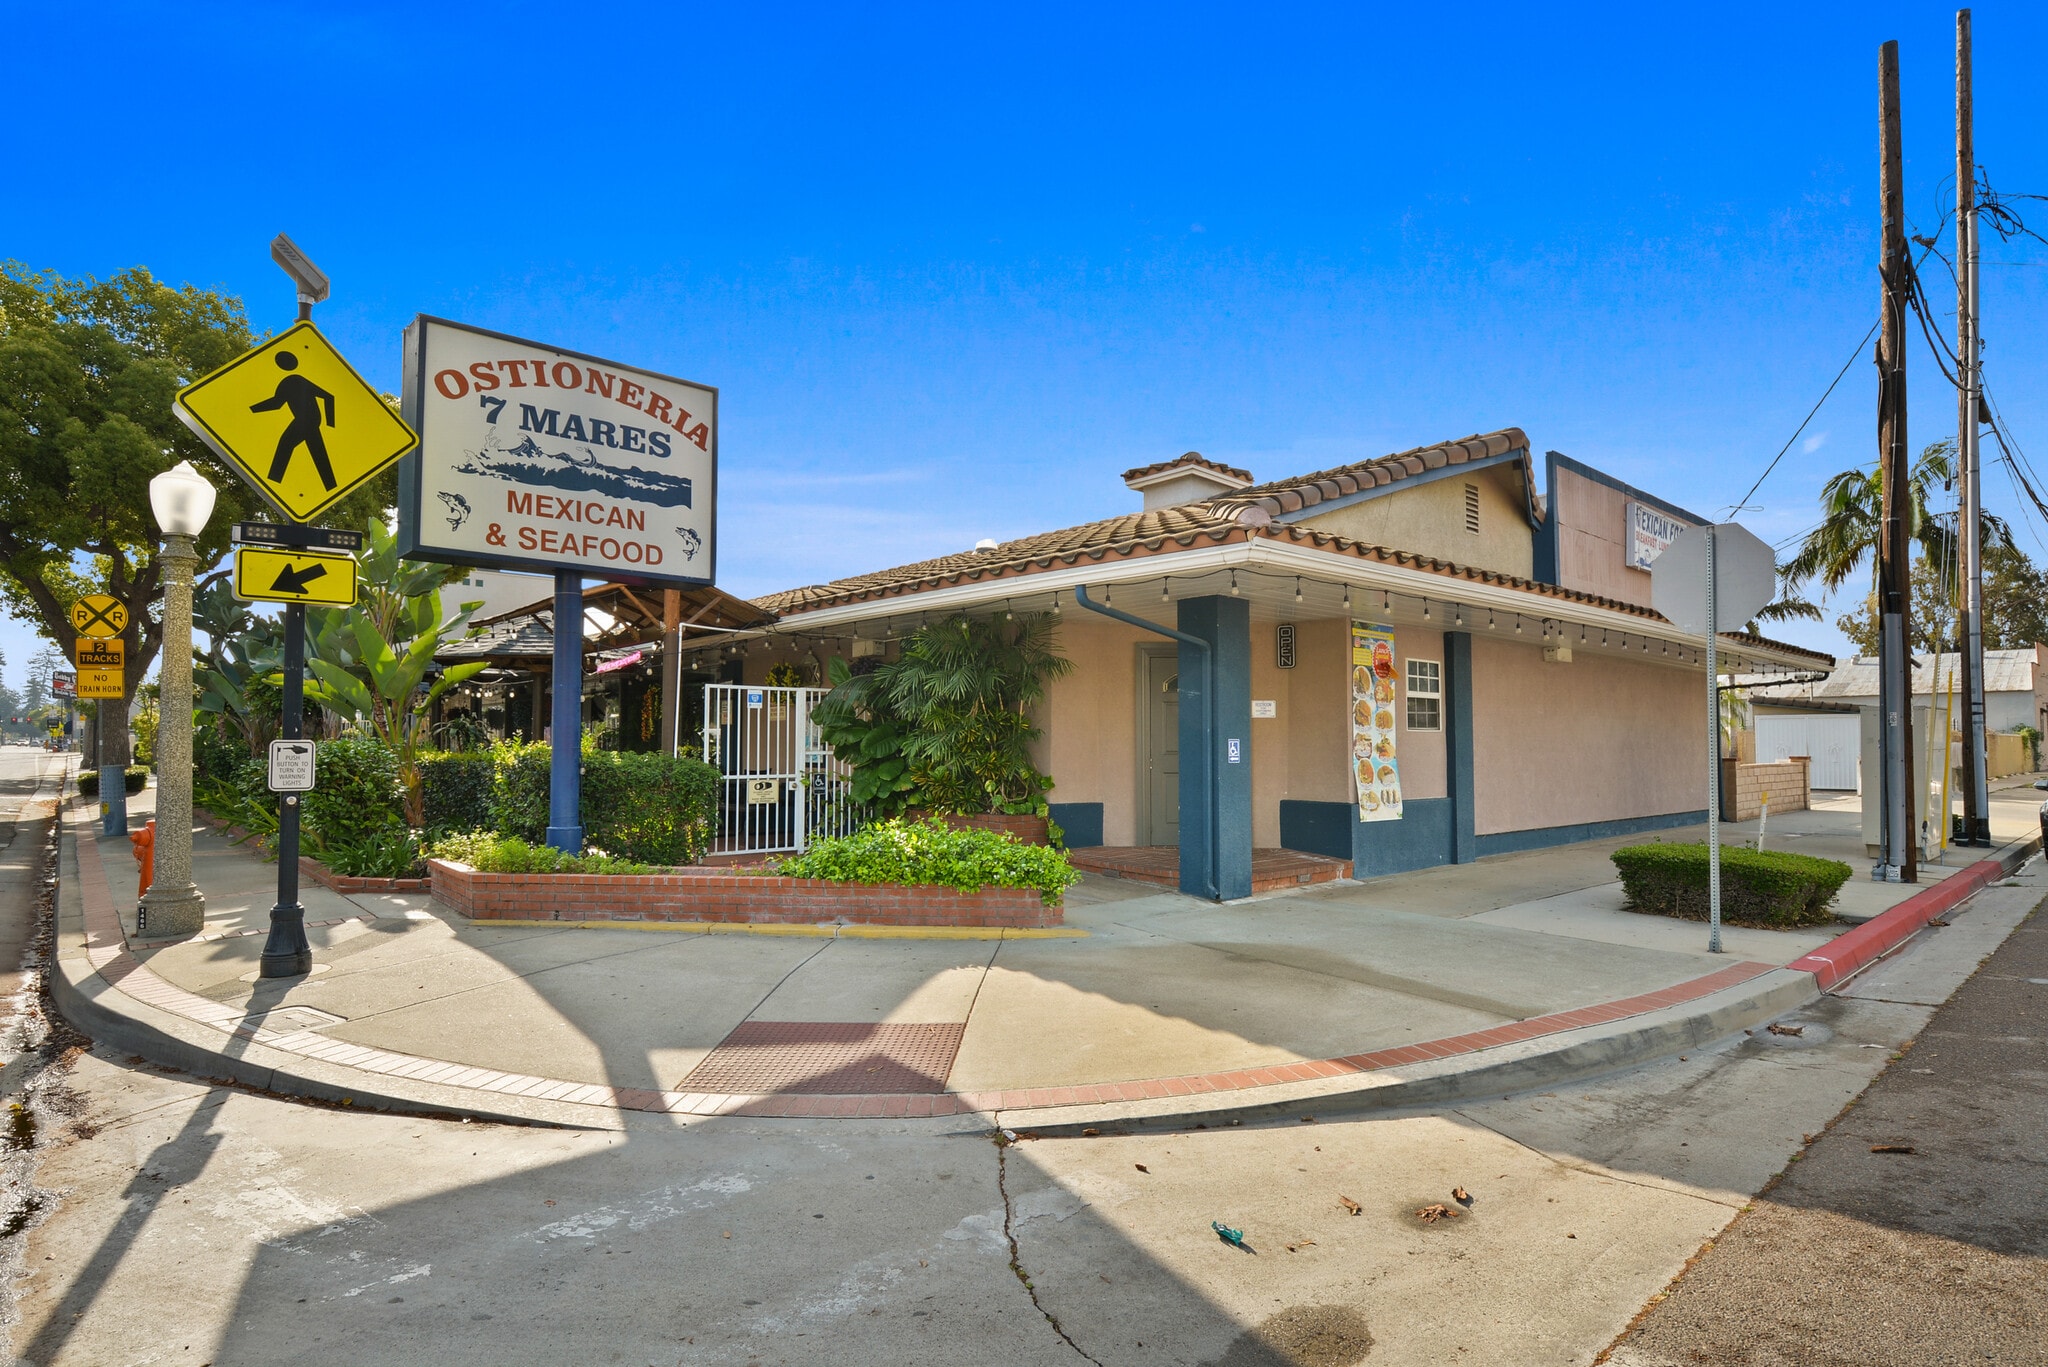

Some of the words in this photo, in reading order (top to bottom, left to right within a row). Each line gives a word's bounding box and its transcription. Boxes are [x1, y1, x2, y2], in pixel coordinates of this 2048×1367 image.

[434, 360, 710, 452] OSTIONERIA
[480, 394, 506, 425] 7
[519, 402, 672, 459] MARES
[507, 490, 645, 531] MEXICAN
[485, 522, 507, 548] &
[518, 526, 663, 566] SEAFOOD
[77, 611, 87, 620] R
[113, 612, 123, 621] R
[81, 654, 119, 662] TRACKS
[96, 643, 104, 652] 2
[1280, 628, 1292, 666] OPEN
[80, 685, 100, 693] TRAIN
[103, 685, 121, 693] HORN
[94, 674, 108, 682] NO
